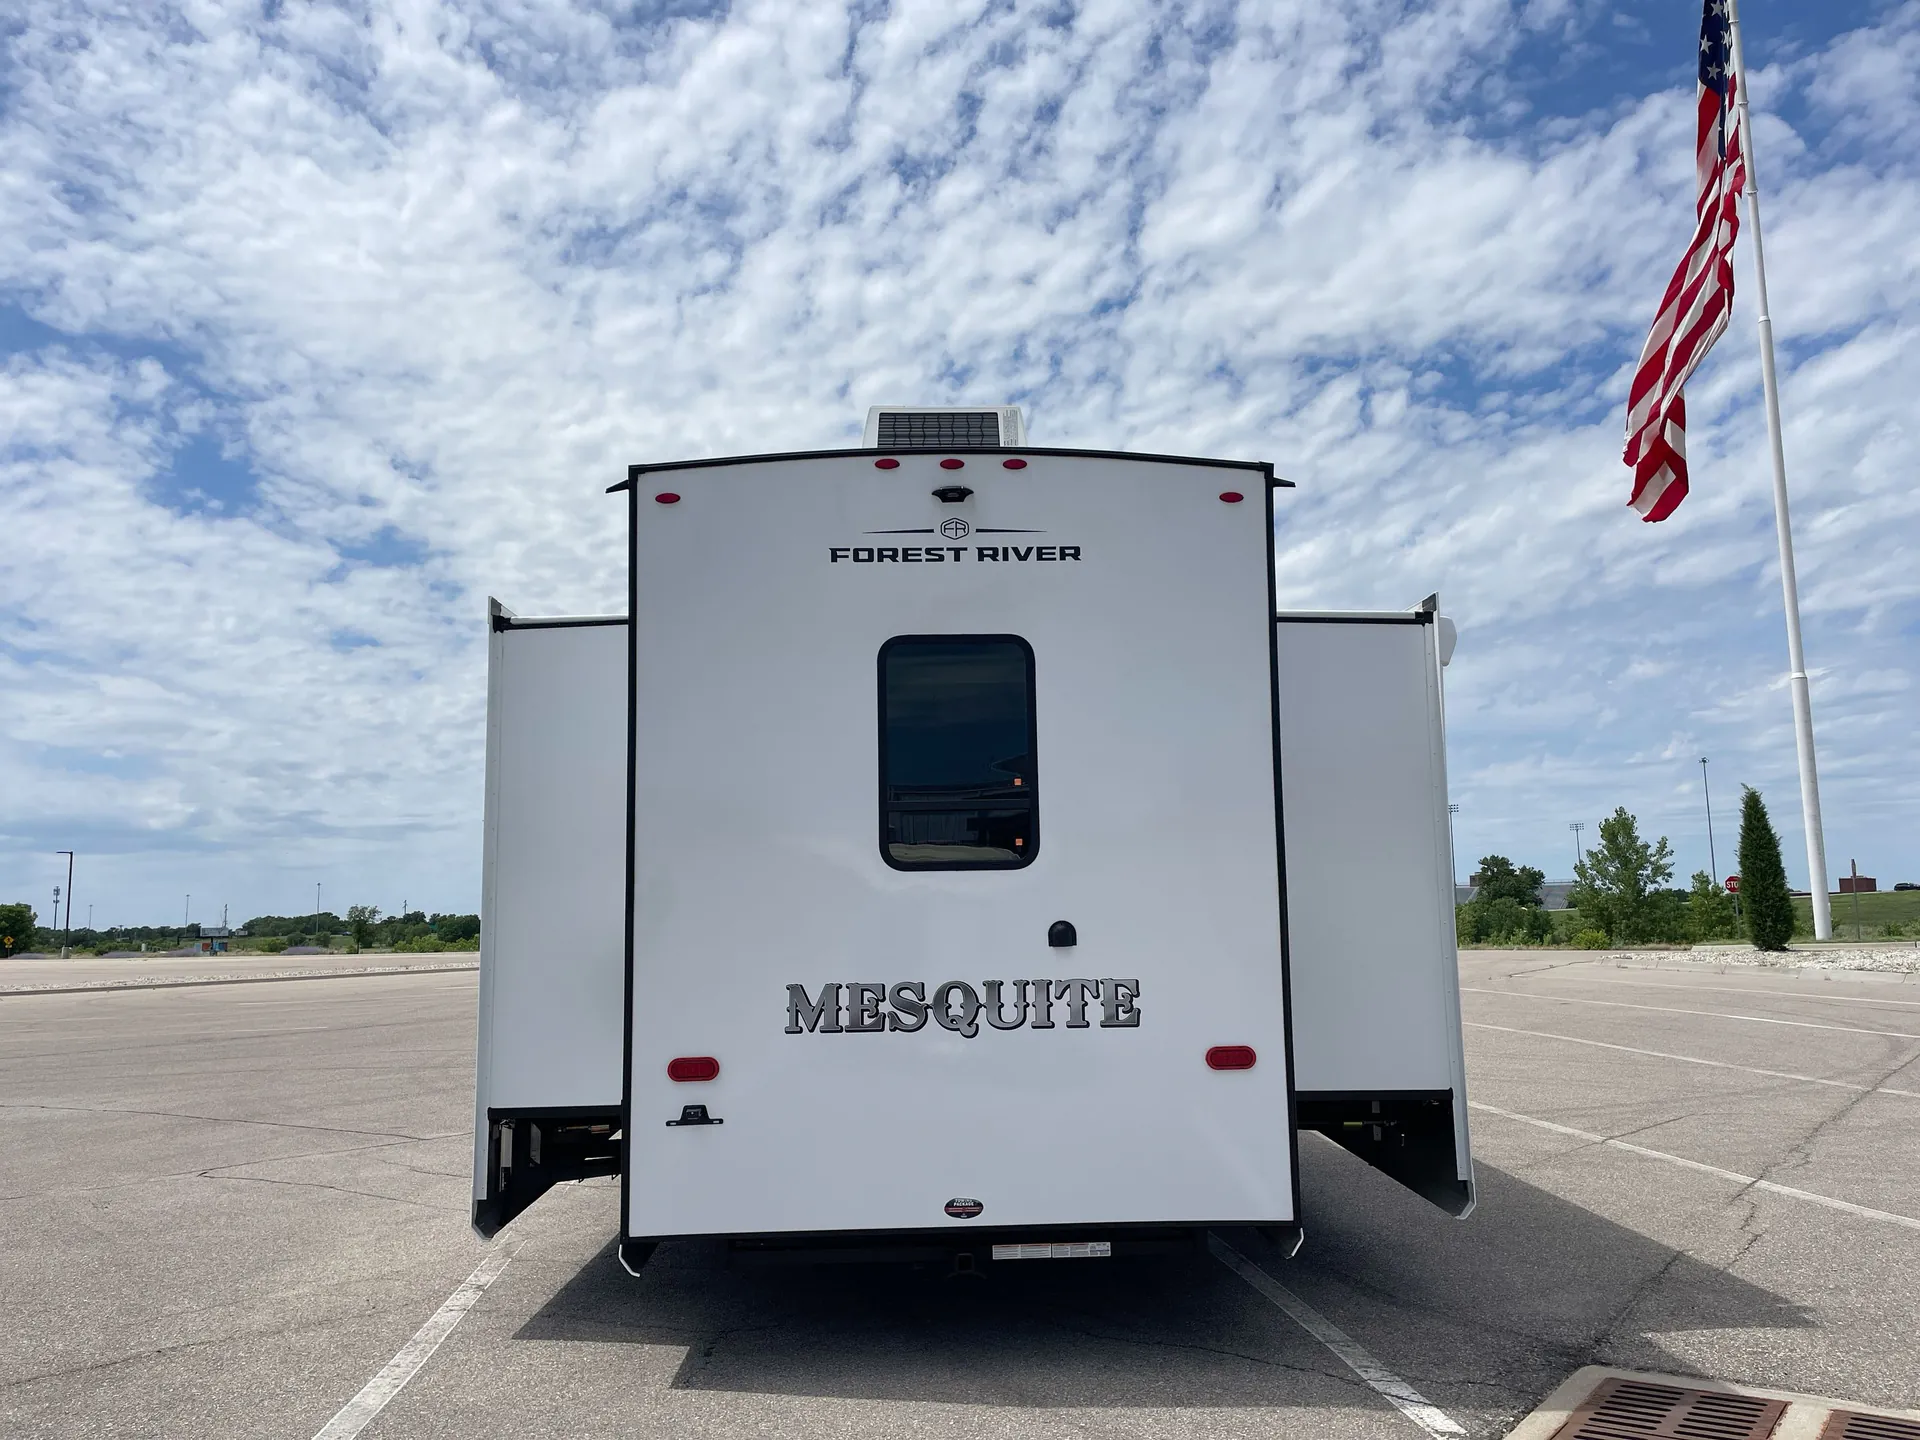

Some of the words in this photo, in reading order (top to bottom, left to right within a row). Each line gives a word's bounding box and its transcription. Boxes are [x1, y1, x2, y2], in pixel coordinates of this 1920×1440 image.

[829, 546, 968, 562] FOREST
[975, 546, 1082, 562] RIVER
[1726, 880, 1739, 889] STO
[785, 978, 1141, 1038] MESQUITE
